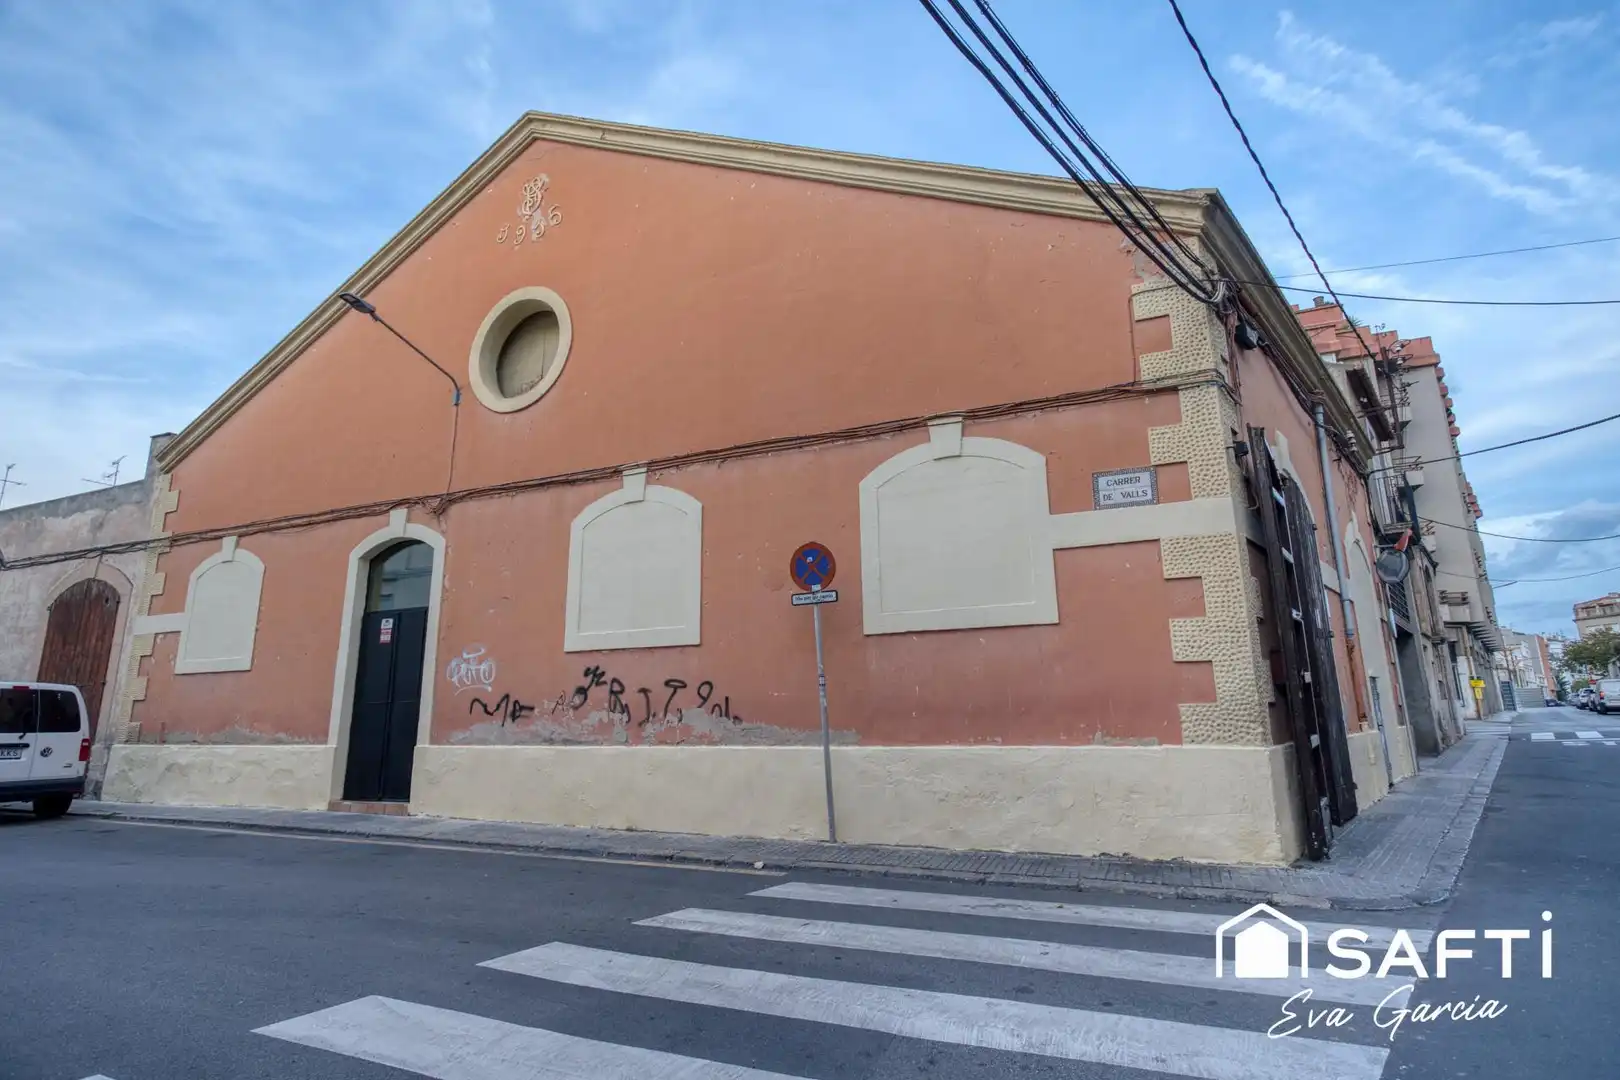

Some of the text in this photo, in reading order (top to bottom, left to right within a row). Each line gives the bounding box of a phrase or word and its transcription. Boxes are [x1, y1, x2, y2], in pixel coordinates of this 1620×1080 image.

[1106, 475, 1141, 487] CARRER
[1102, 489, 1148, 502] DE VALLS
